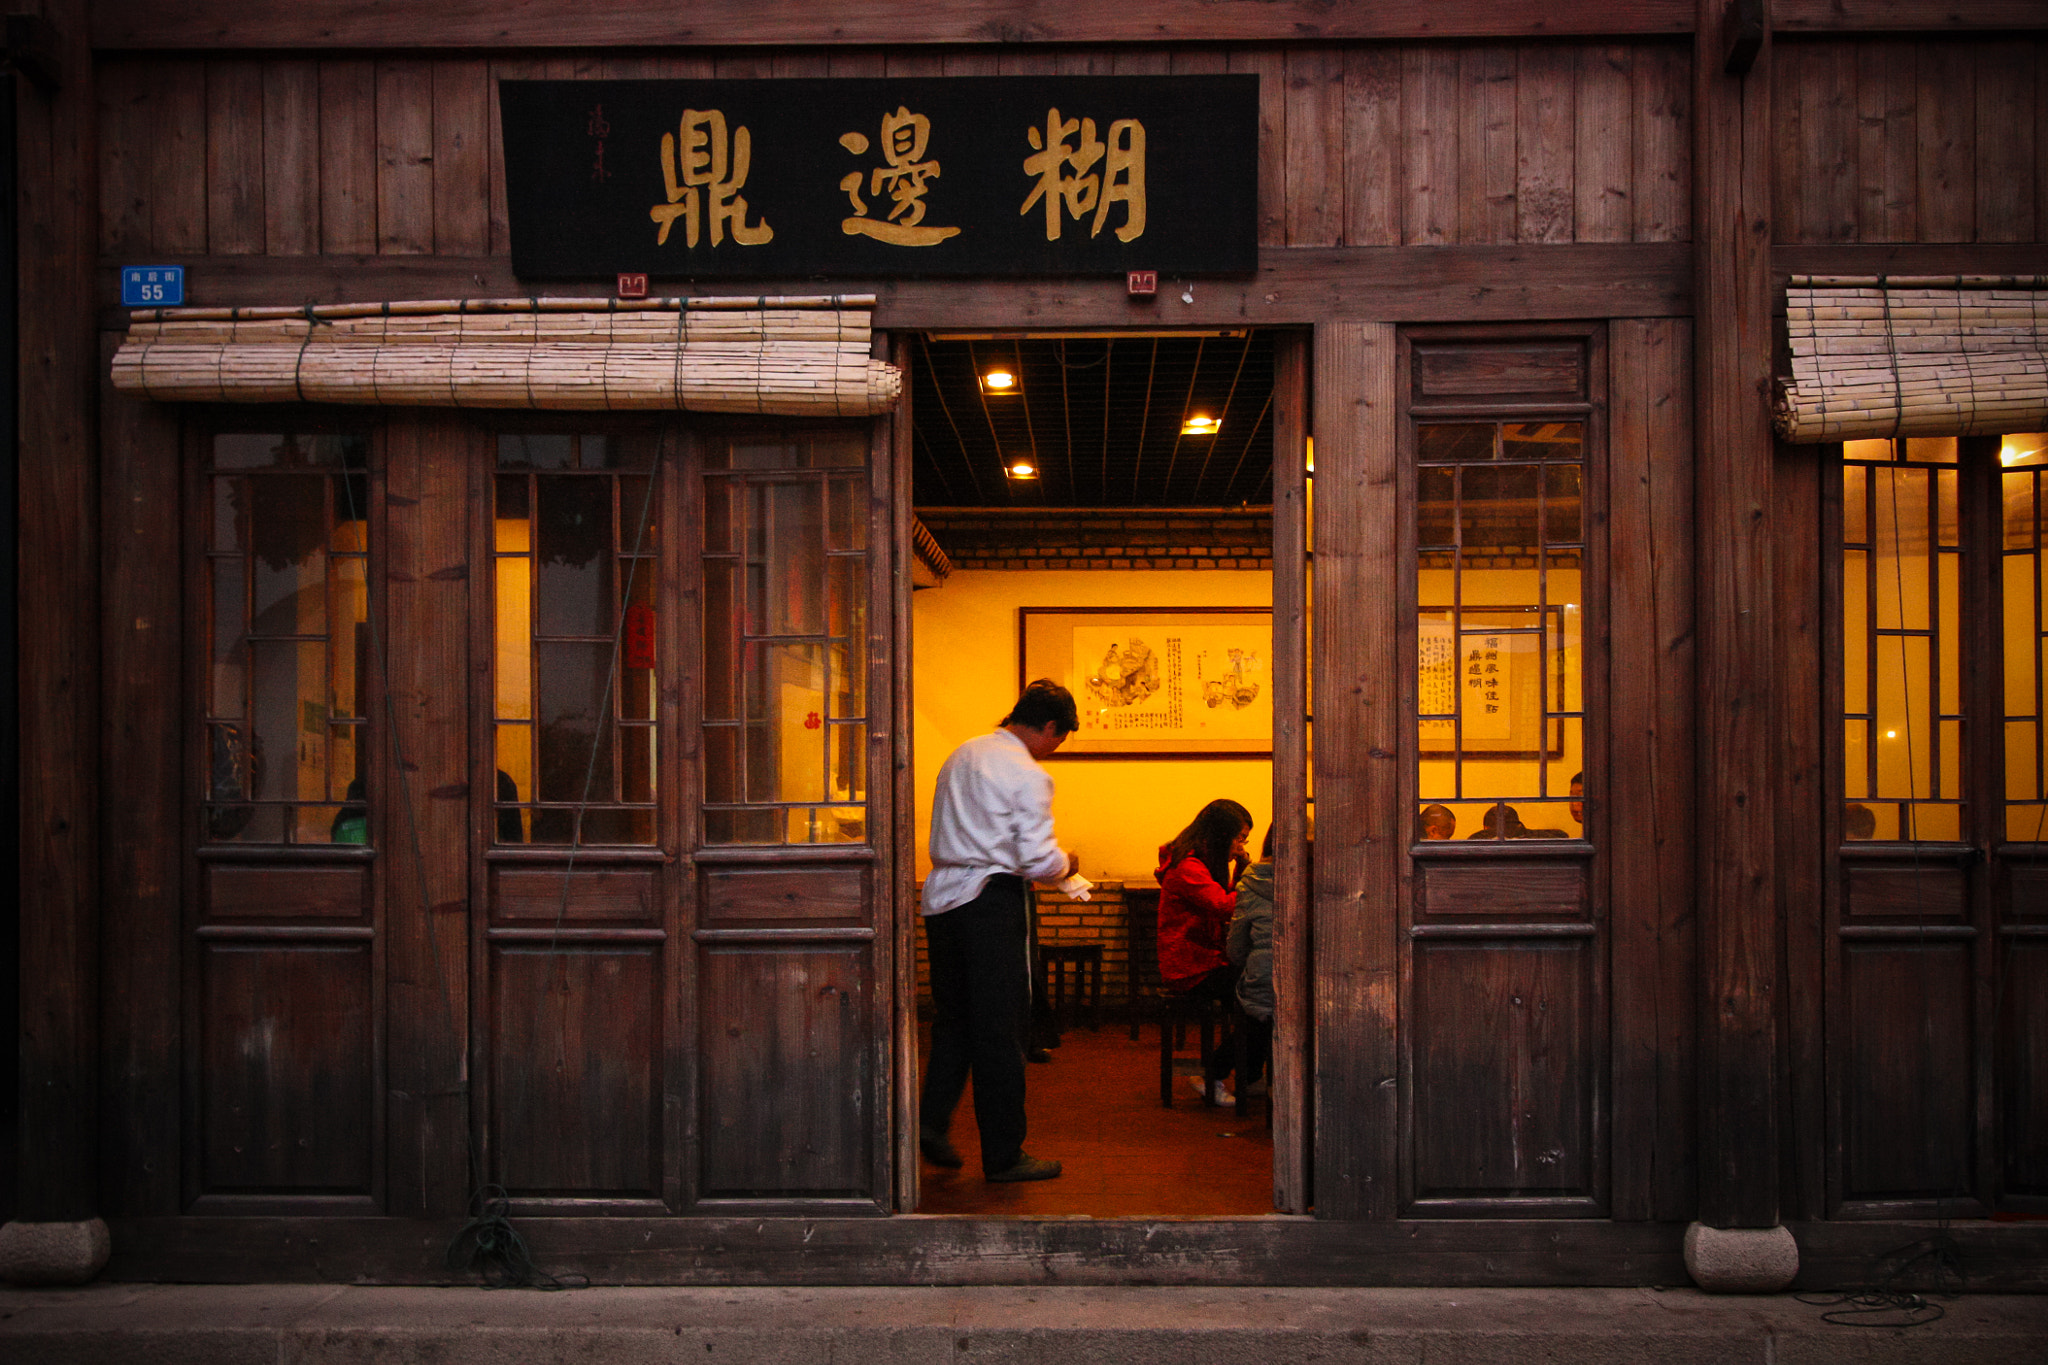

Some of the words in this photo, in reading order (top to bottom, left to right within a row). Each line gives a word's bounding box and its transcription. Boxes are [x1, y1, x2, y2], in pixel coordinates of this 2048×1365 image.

[649, 105, 1147, 248] 鼎邊糊
[141, 284, 164, 301] 55
